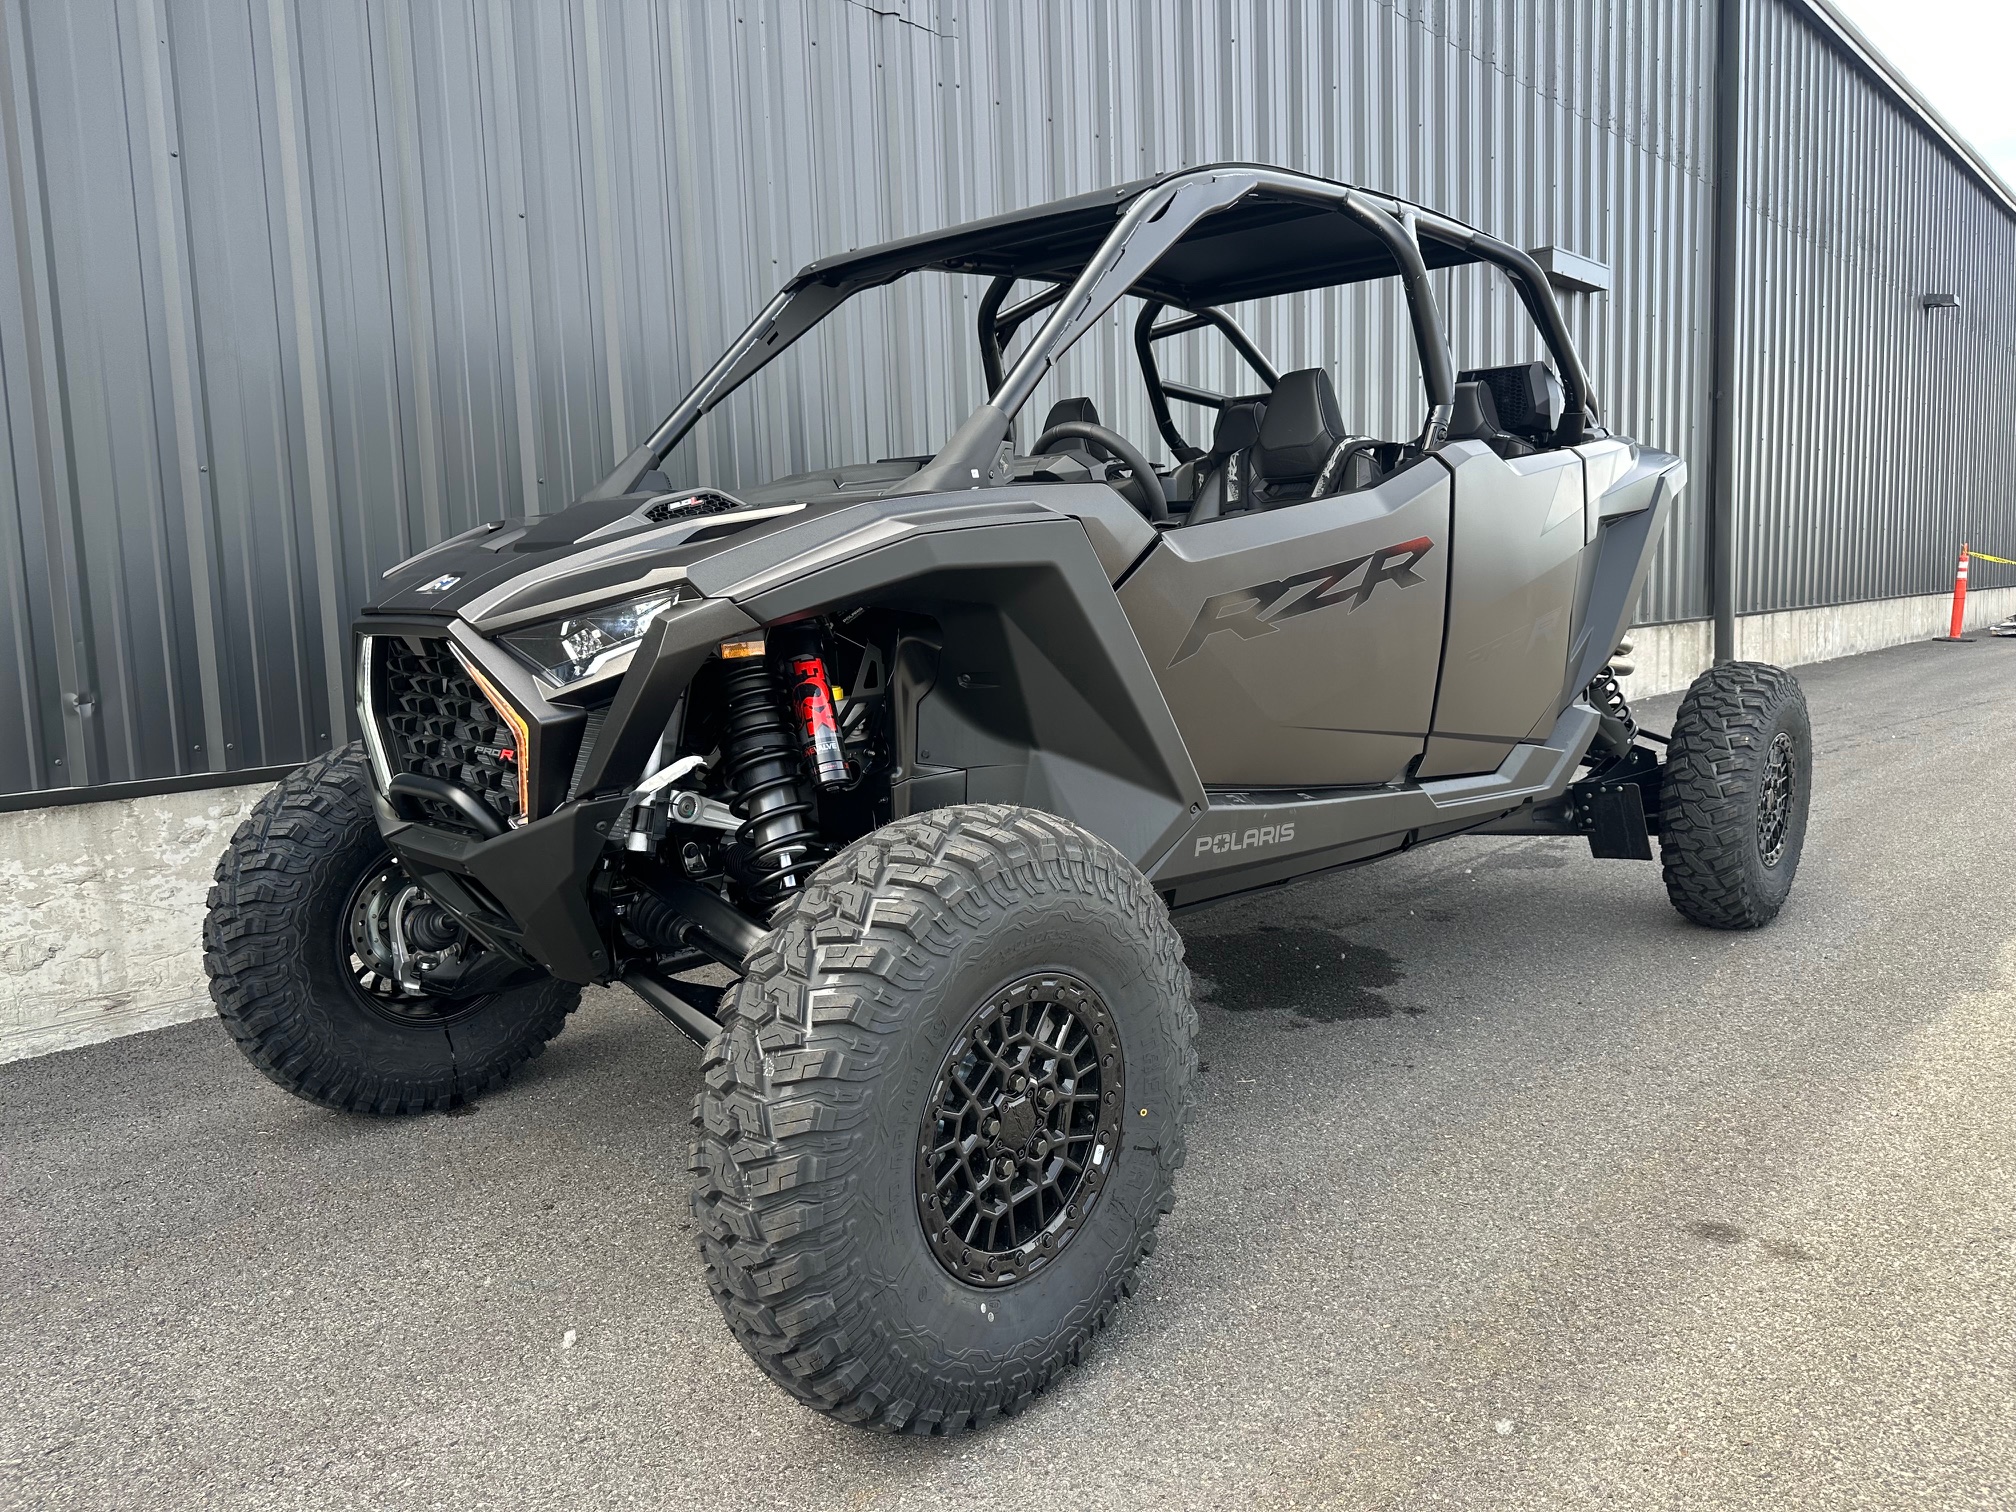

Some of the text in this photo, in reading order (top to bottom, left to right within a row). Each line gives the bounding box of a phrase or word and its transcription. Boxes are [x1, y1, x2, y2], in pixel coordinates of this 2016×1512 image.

[1165, 535, 1435, 669] RZR
[793, 657, 837, 737] FOX
[1195, 823, 1295, 857] POLARIS
